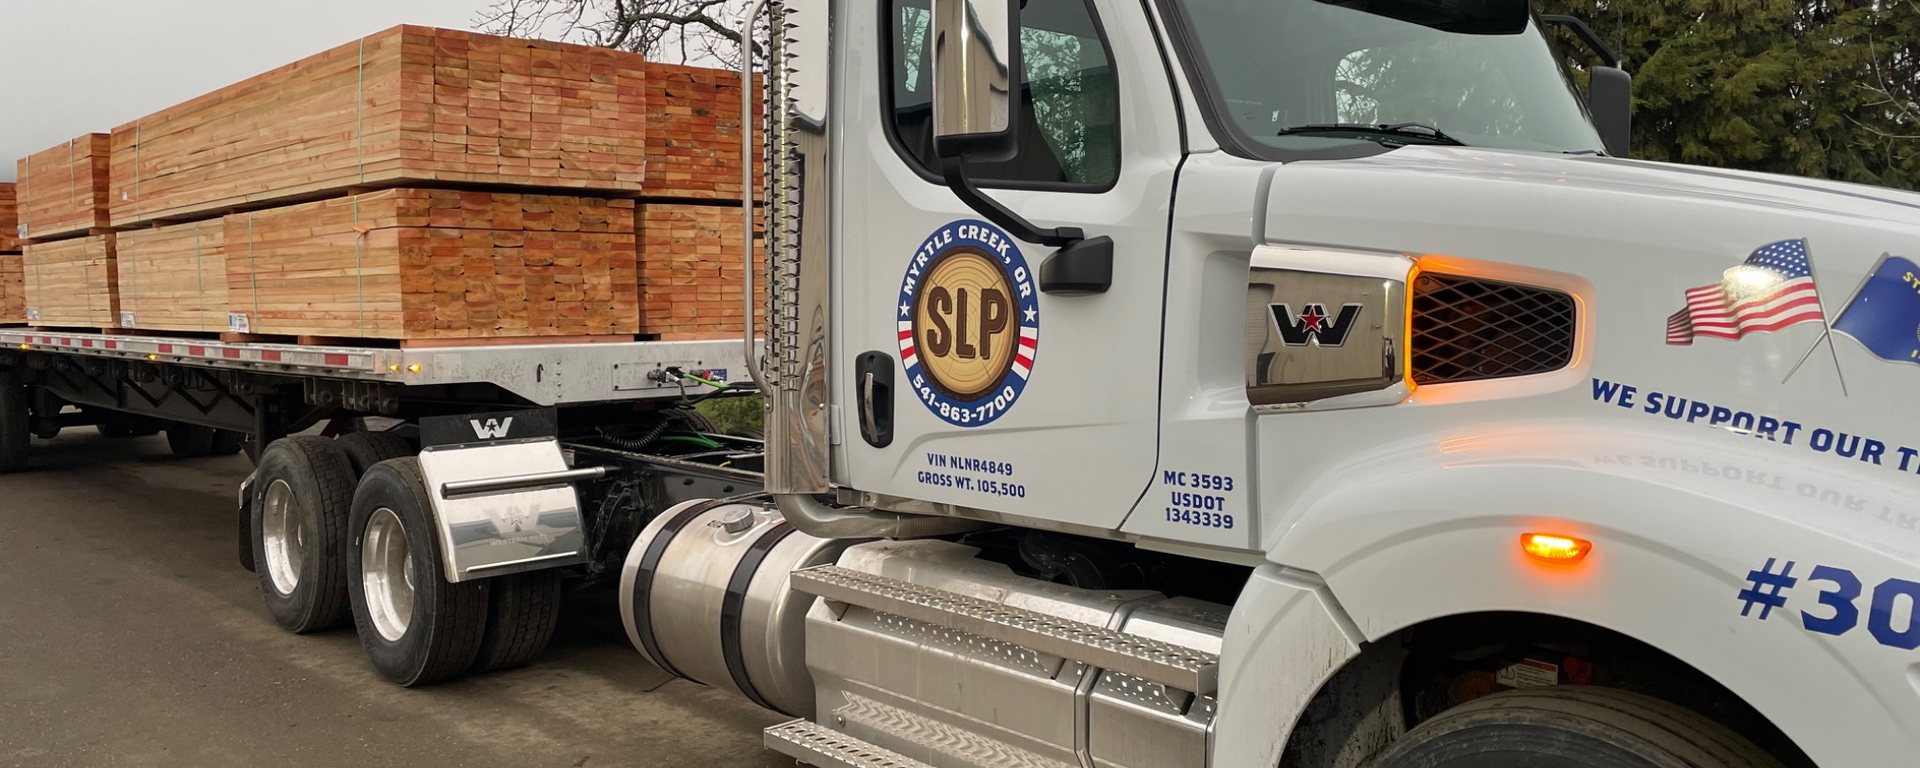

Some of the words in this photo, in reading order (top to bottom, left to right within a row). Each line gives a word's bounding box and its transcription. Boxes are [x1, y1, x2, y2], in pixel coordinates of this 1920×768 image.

[904, 229, 953, 296] MYRTLE
[958, 225, 1011, 264] CREEK,
[1014, 266, 1032, 299] OR
[927, 286, 1009, 360] SLP
[913, 374, 1016, 423] 541-863-7700
[1592, 378, 1637, 409] WE
[1644, 392, 1802, 445] SUPPORT
[1809, 428, 1886, 466] OUR
[1896, 446, 1920, 475] T
[927, 453, 946, 467] VIN
[950, 456, 1013, 476] NLNR4849
[918, 471, 953, 487] GROSS
[955, 476, 974, 491] WT.
[977, 480, 1025, 498] 105,500
[1164, 470, 1186, 486] MC
[1190, 473, 1234, 492] 3593
[1171, 491, 1225, 511] USDOT
[1165, 507, 1234, 529] 1343339
